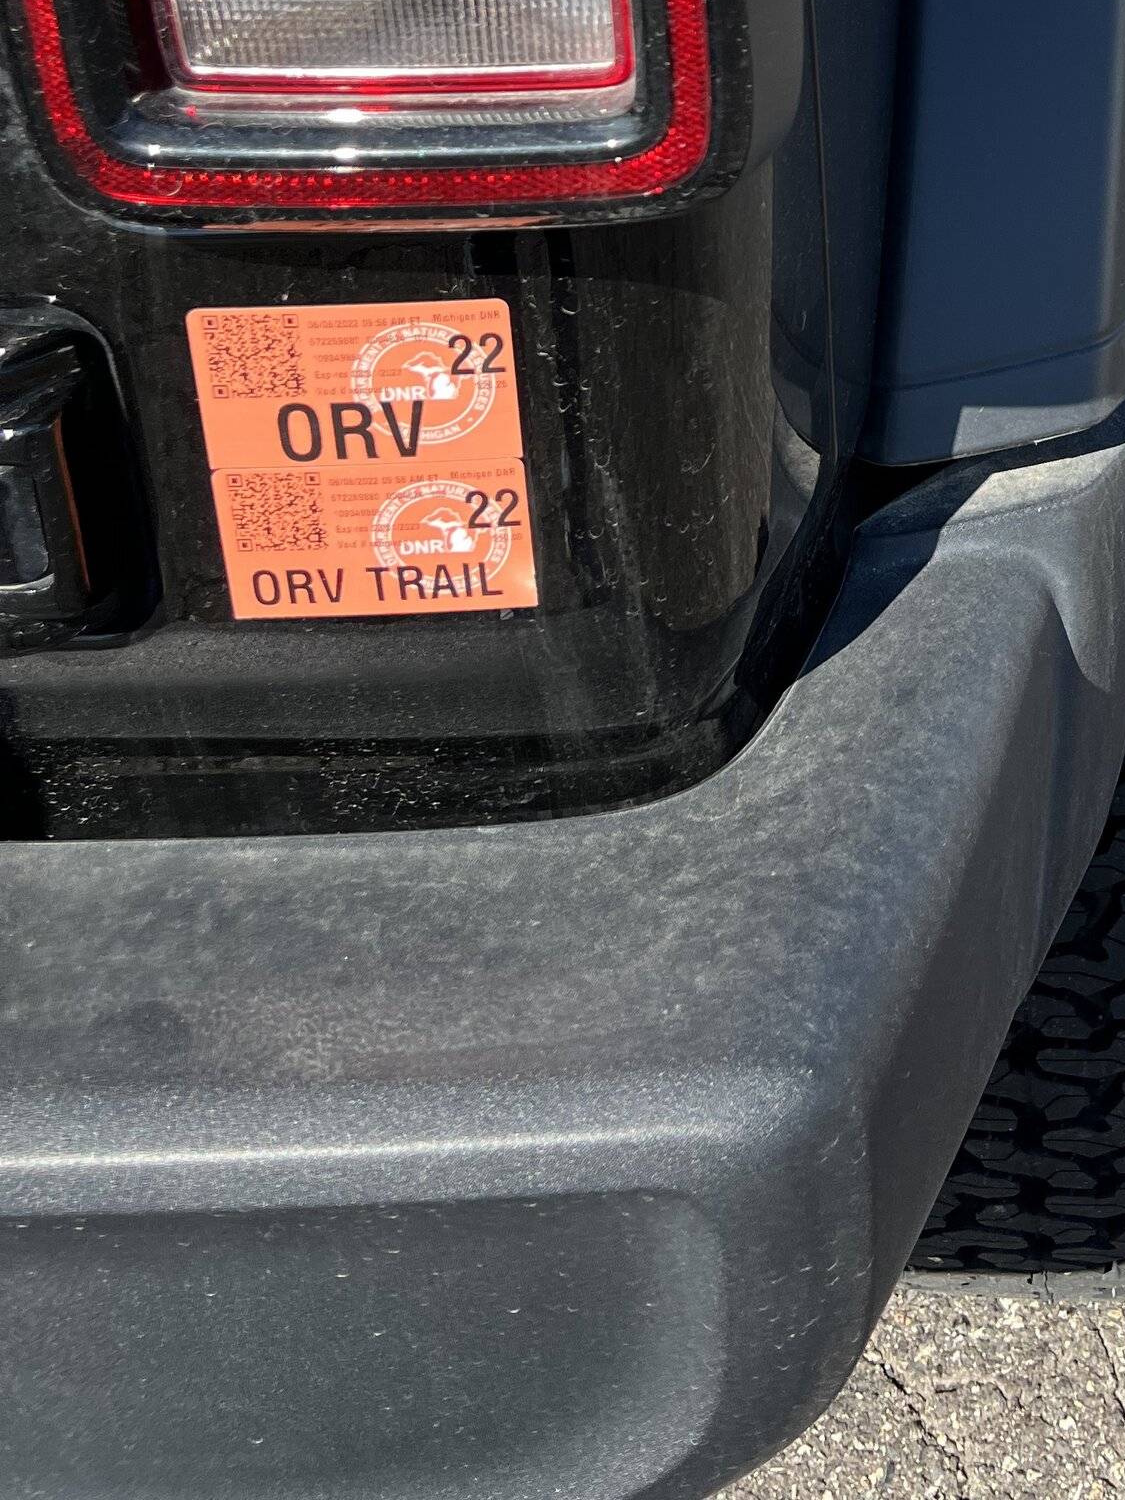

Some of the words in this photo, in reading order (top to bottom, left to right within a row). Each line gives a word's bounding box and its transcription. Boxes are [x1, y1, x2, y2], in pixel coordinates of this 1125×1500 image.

[448, 332, 507, 375] 22
[379, 385, 427, 402] DNR
[277, 401, 424, 462] ORV
[465, 488, 522, 529] 22
[401, 539, 445, 556] DNR
[252, 568, 344, 606] ORV
[366, 562, 504, 602] TRAIL
